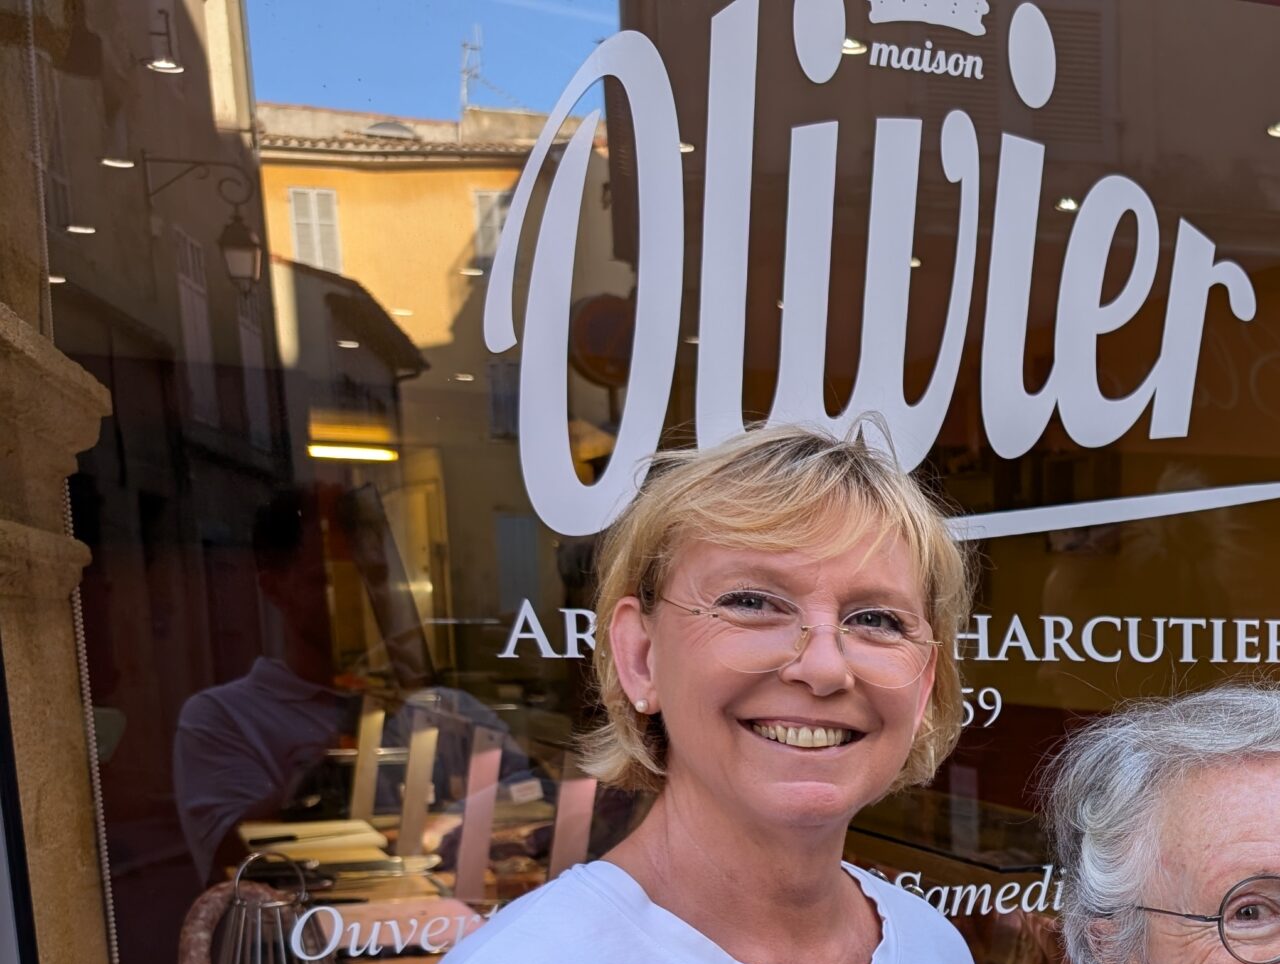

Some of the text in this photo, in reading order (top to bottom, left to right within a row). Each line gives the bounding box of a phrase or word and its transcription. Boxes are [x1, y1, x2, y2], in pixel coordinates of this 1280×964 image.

[870, 40, 984, 80] maison
[484, 0, 1257, 537] Olivier
[961, 687, 1002, 728] 59
[290, 904, 498, 961] Ouver
